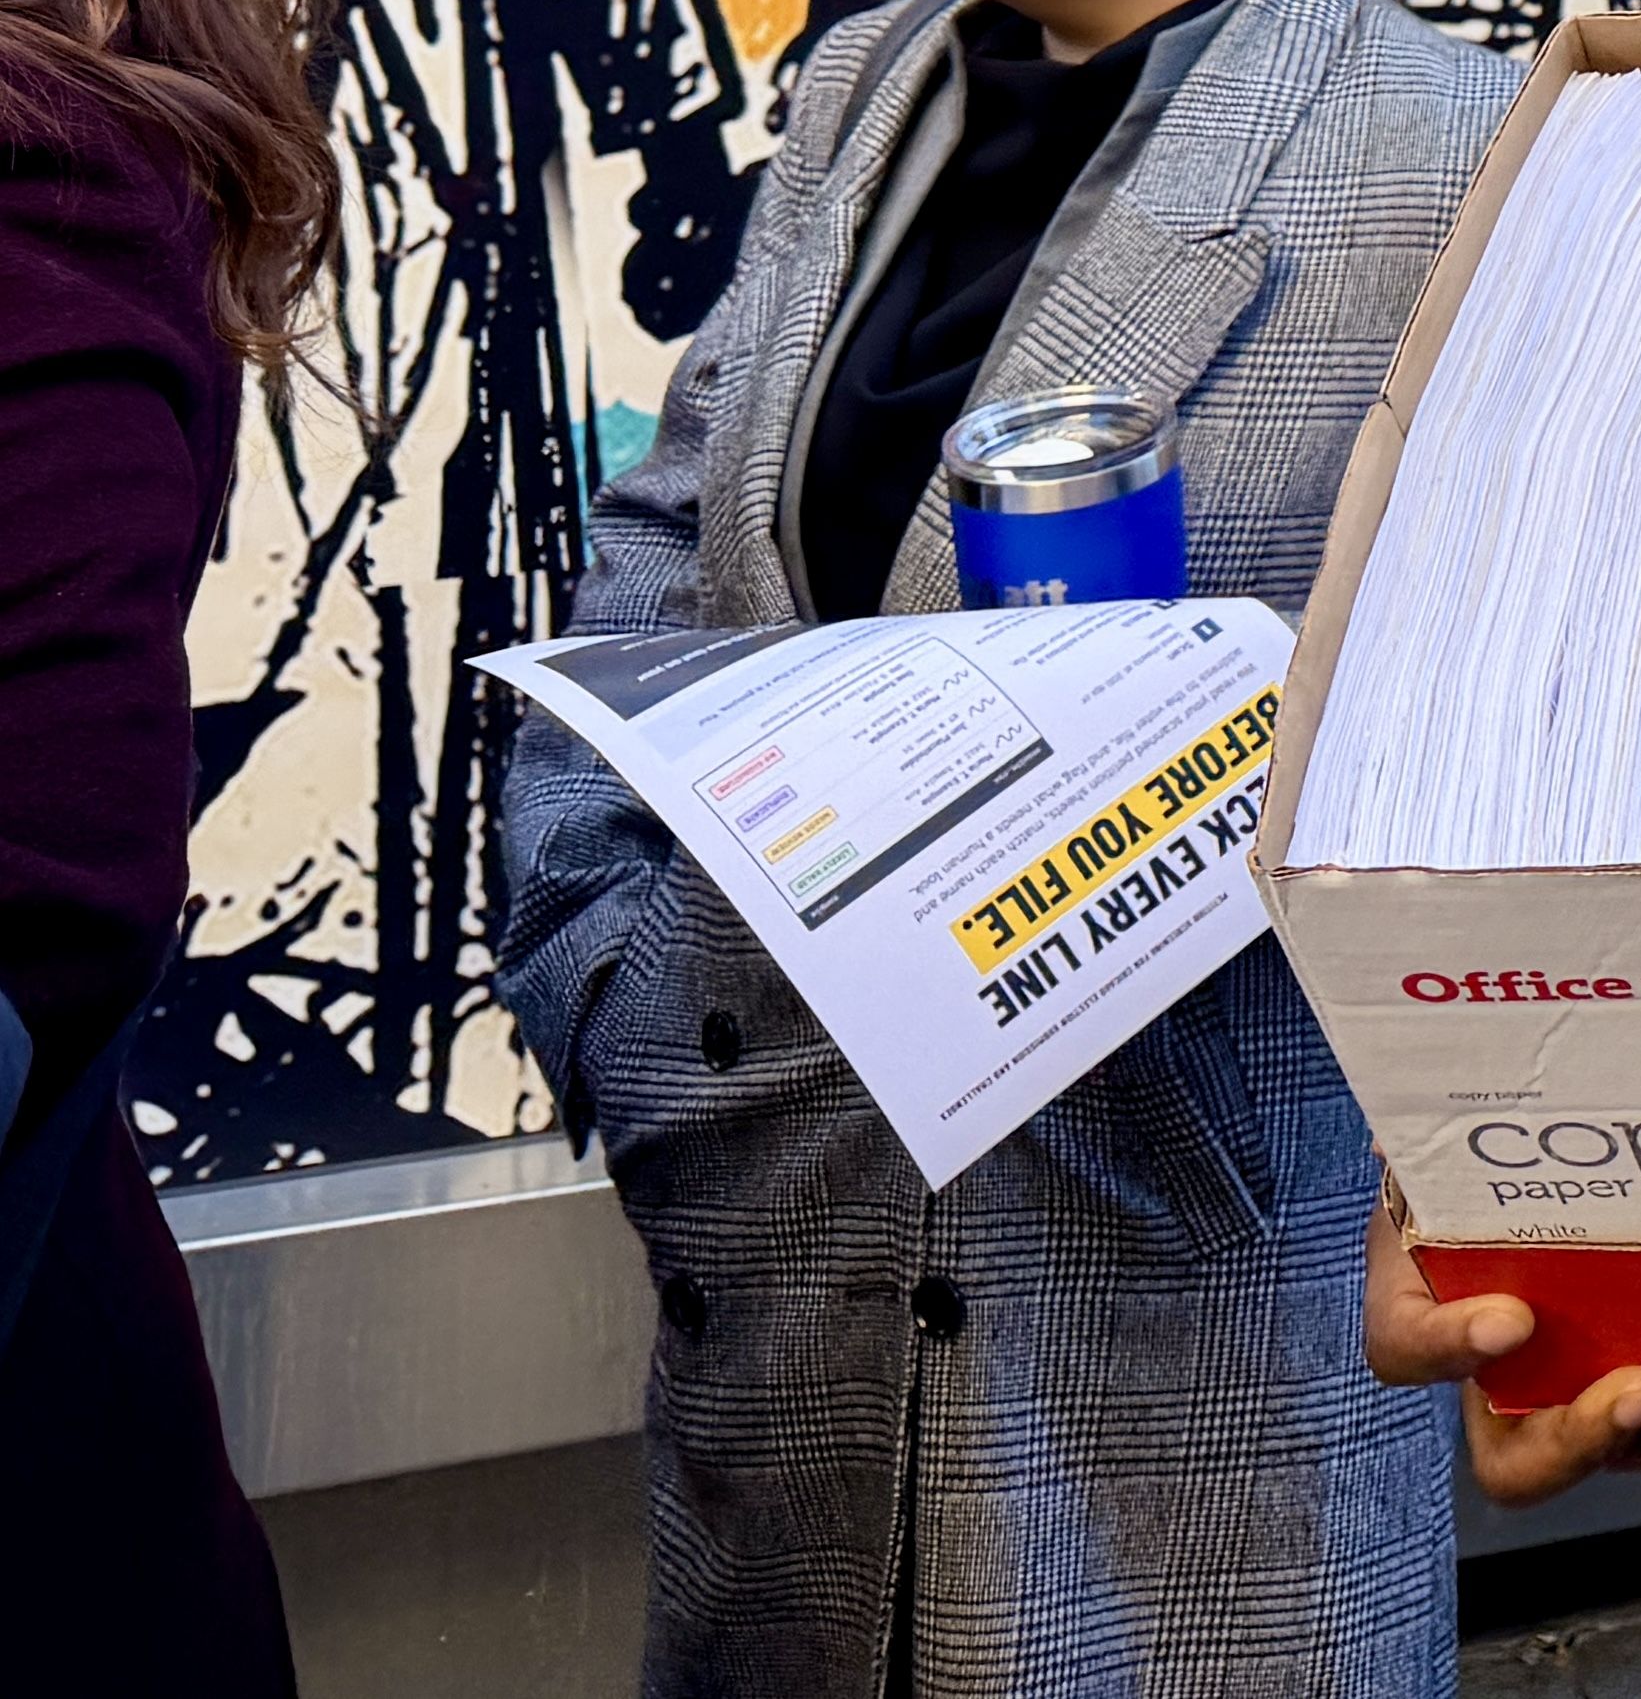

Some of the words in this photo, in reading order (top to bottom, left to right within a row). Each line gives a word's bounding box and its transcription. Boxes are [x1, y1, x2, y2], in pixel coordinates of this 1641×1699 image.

[1198, 646, 1243, 681] address
[1164, 690, 1186, 707] the
[1184, 679, 1200, 692] to
[1208, 676, 1237, 701] read
[1135, 705, 1164, 731] voter
[1183, 693, 1210, 720] your
[1133, 715, 1183, 757] scanned
[1086, 744, 1110, 768] and
[1088, 750, 1134, 790] petition
[1060, 762, 1089, 784] flag
[1032, 780, 1062, 807] what
[1043, 786, 1089, 820] sheets,
[993, 802, 1033, 833] needs
[984, 830, 994, 841] a
[1005, 819, 1045, 851] match
[1066, 802, 1152, 880] YOU
[940, 838, 987, 873] human
[973, 848, 1006, 874] each
[907, 871, 943, 894] look.
[938, 871, 975, 902] name
[1080, 835, 1206, 953] EVERY
[912, 898, 938, 923] and
[962, 858, 1071, 949] FILE.
[978, 932, 1081, 1027] LINE
[1401, 970, 1635, 1004] Office
[1487, 1175, 1635, 1206] paper
[1507, 1222, 1588, 1239] white
